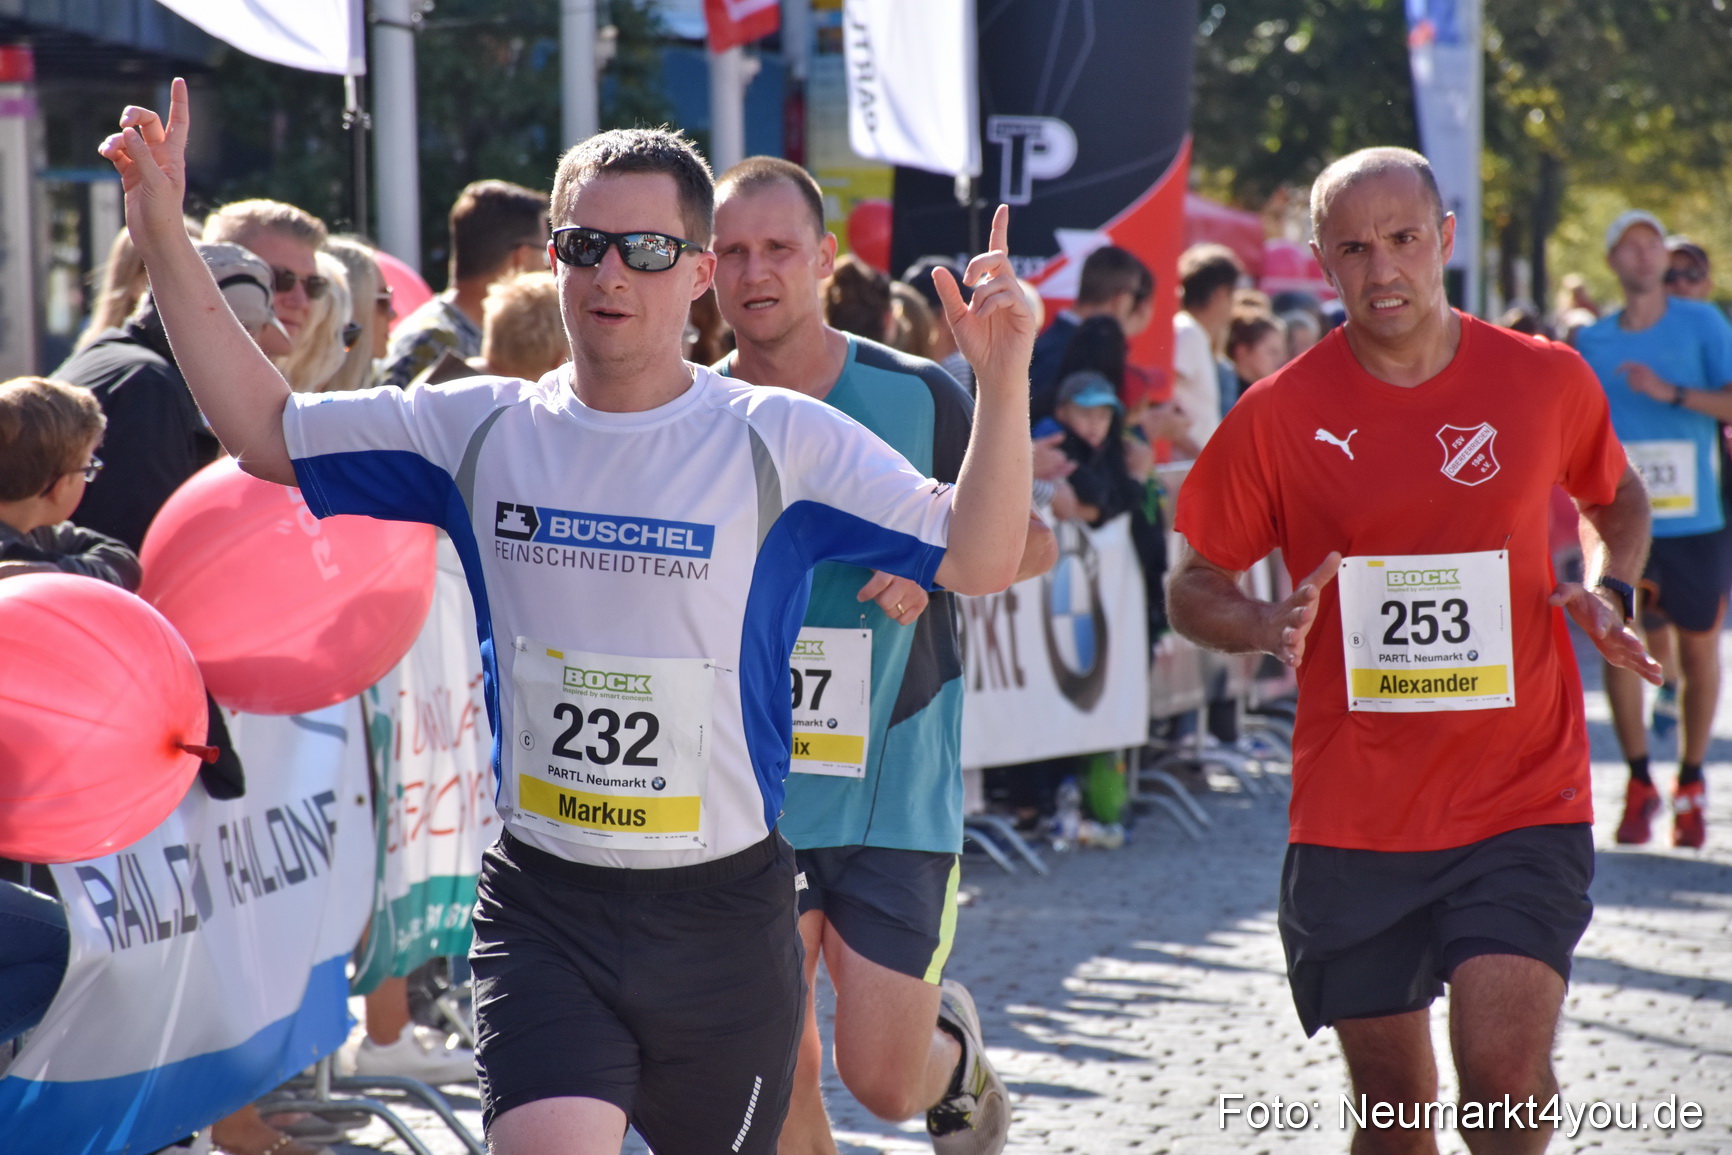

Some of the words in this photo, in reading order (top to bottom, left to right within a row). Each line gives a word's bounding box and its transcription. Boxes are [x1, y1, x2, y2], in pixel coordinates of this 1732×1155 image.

[1447, 427, 1491, 474] OBERFERRIEDEN
[1451, 435, 1465, 449] FSV
[549, 516, 705, 552] BÜSCHEL
[494, 539, 710, 581] FEINSCHNEIDTEAM
[1386, 568, 1460, 587] BOCK
[1380, 598, 1471, 646] 253
[791, 640, 825, 656] CK
[1353, 636, 1360, 645] B
[1378, 653, 1411, 663] PARTL
[1414, 652, 1463, 663] Neumarkt
[563, 666, 653, 694] BOCK
[1379, 673, 1479, 694] Alexander
[562, 687, 589, 697] inspired
[589, 690, 599, 698] by
[599, 692, 620, 700] smart
[621, 694, 653, 702] concepts
[524, 735, 530, 746] C
[551, 702, 660, 767] 232
[547, 764, 584, 783] PARTL
[586, 774, 647, 789] Neumarkt
[558, 793, 647, 828] Markus
